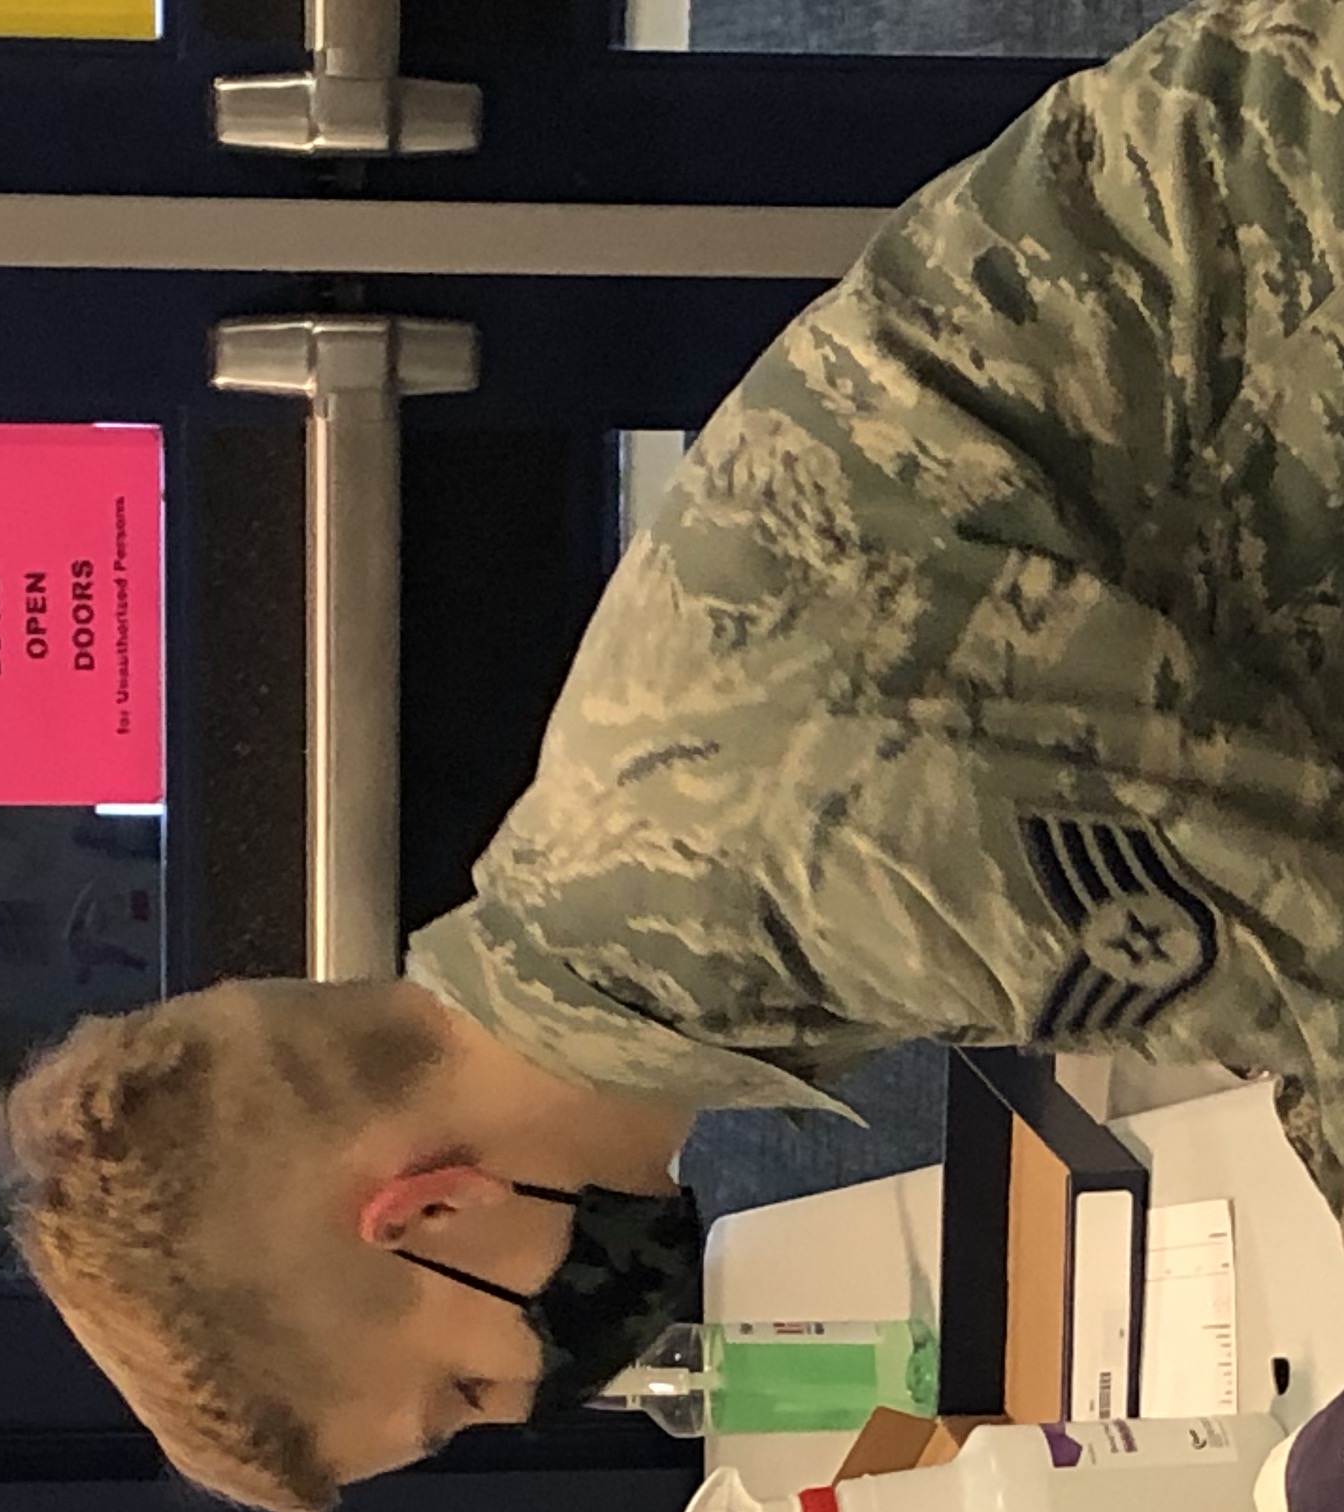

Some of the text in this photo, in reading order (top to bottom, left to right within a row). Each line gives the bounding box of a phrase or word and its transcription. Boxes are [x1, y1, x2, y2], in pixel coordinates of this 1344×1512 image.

[25, 572, 48, 659] OPEN
[71, 560, 95, 671] DOORS
[113, 497, 130, 734] for Unauthorized Persons
